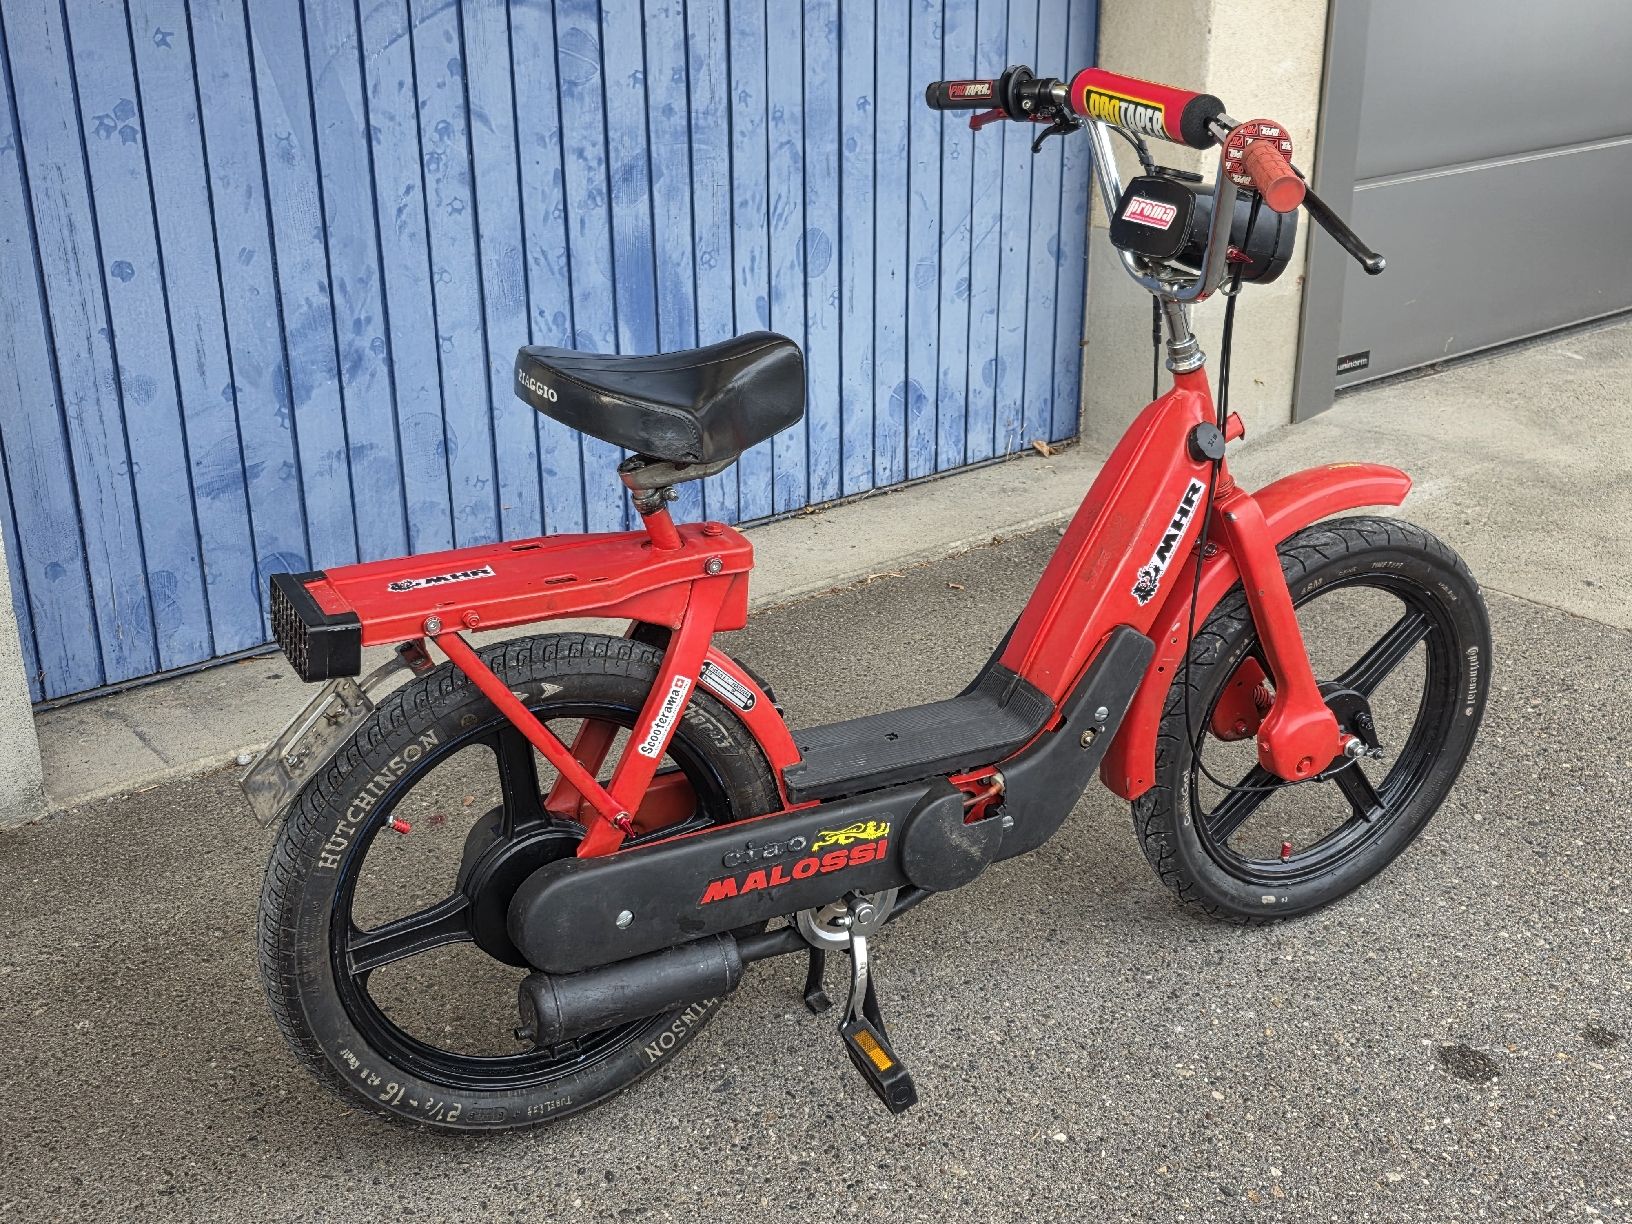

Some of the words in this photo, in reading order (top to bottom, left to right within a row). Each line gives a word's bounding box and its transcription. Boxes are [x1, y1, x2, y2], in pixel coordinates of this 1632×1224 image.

[1125, 199, 1175, 222] proma
[1155, 482, 1202, 565] MHR
[425, 568, 492, 585] MHR
[640, 688, 681, 755] Scooterama
[318, 728, 440, 869] HUTCHINSON
[700, 839, 889, 905] MALOSSI
[722, 836, 808, 868] ciao
